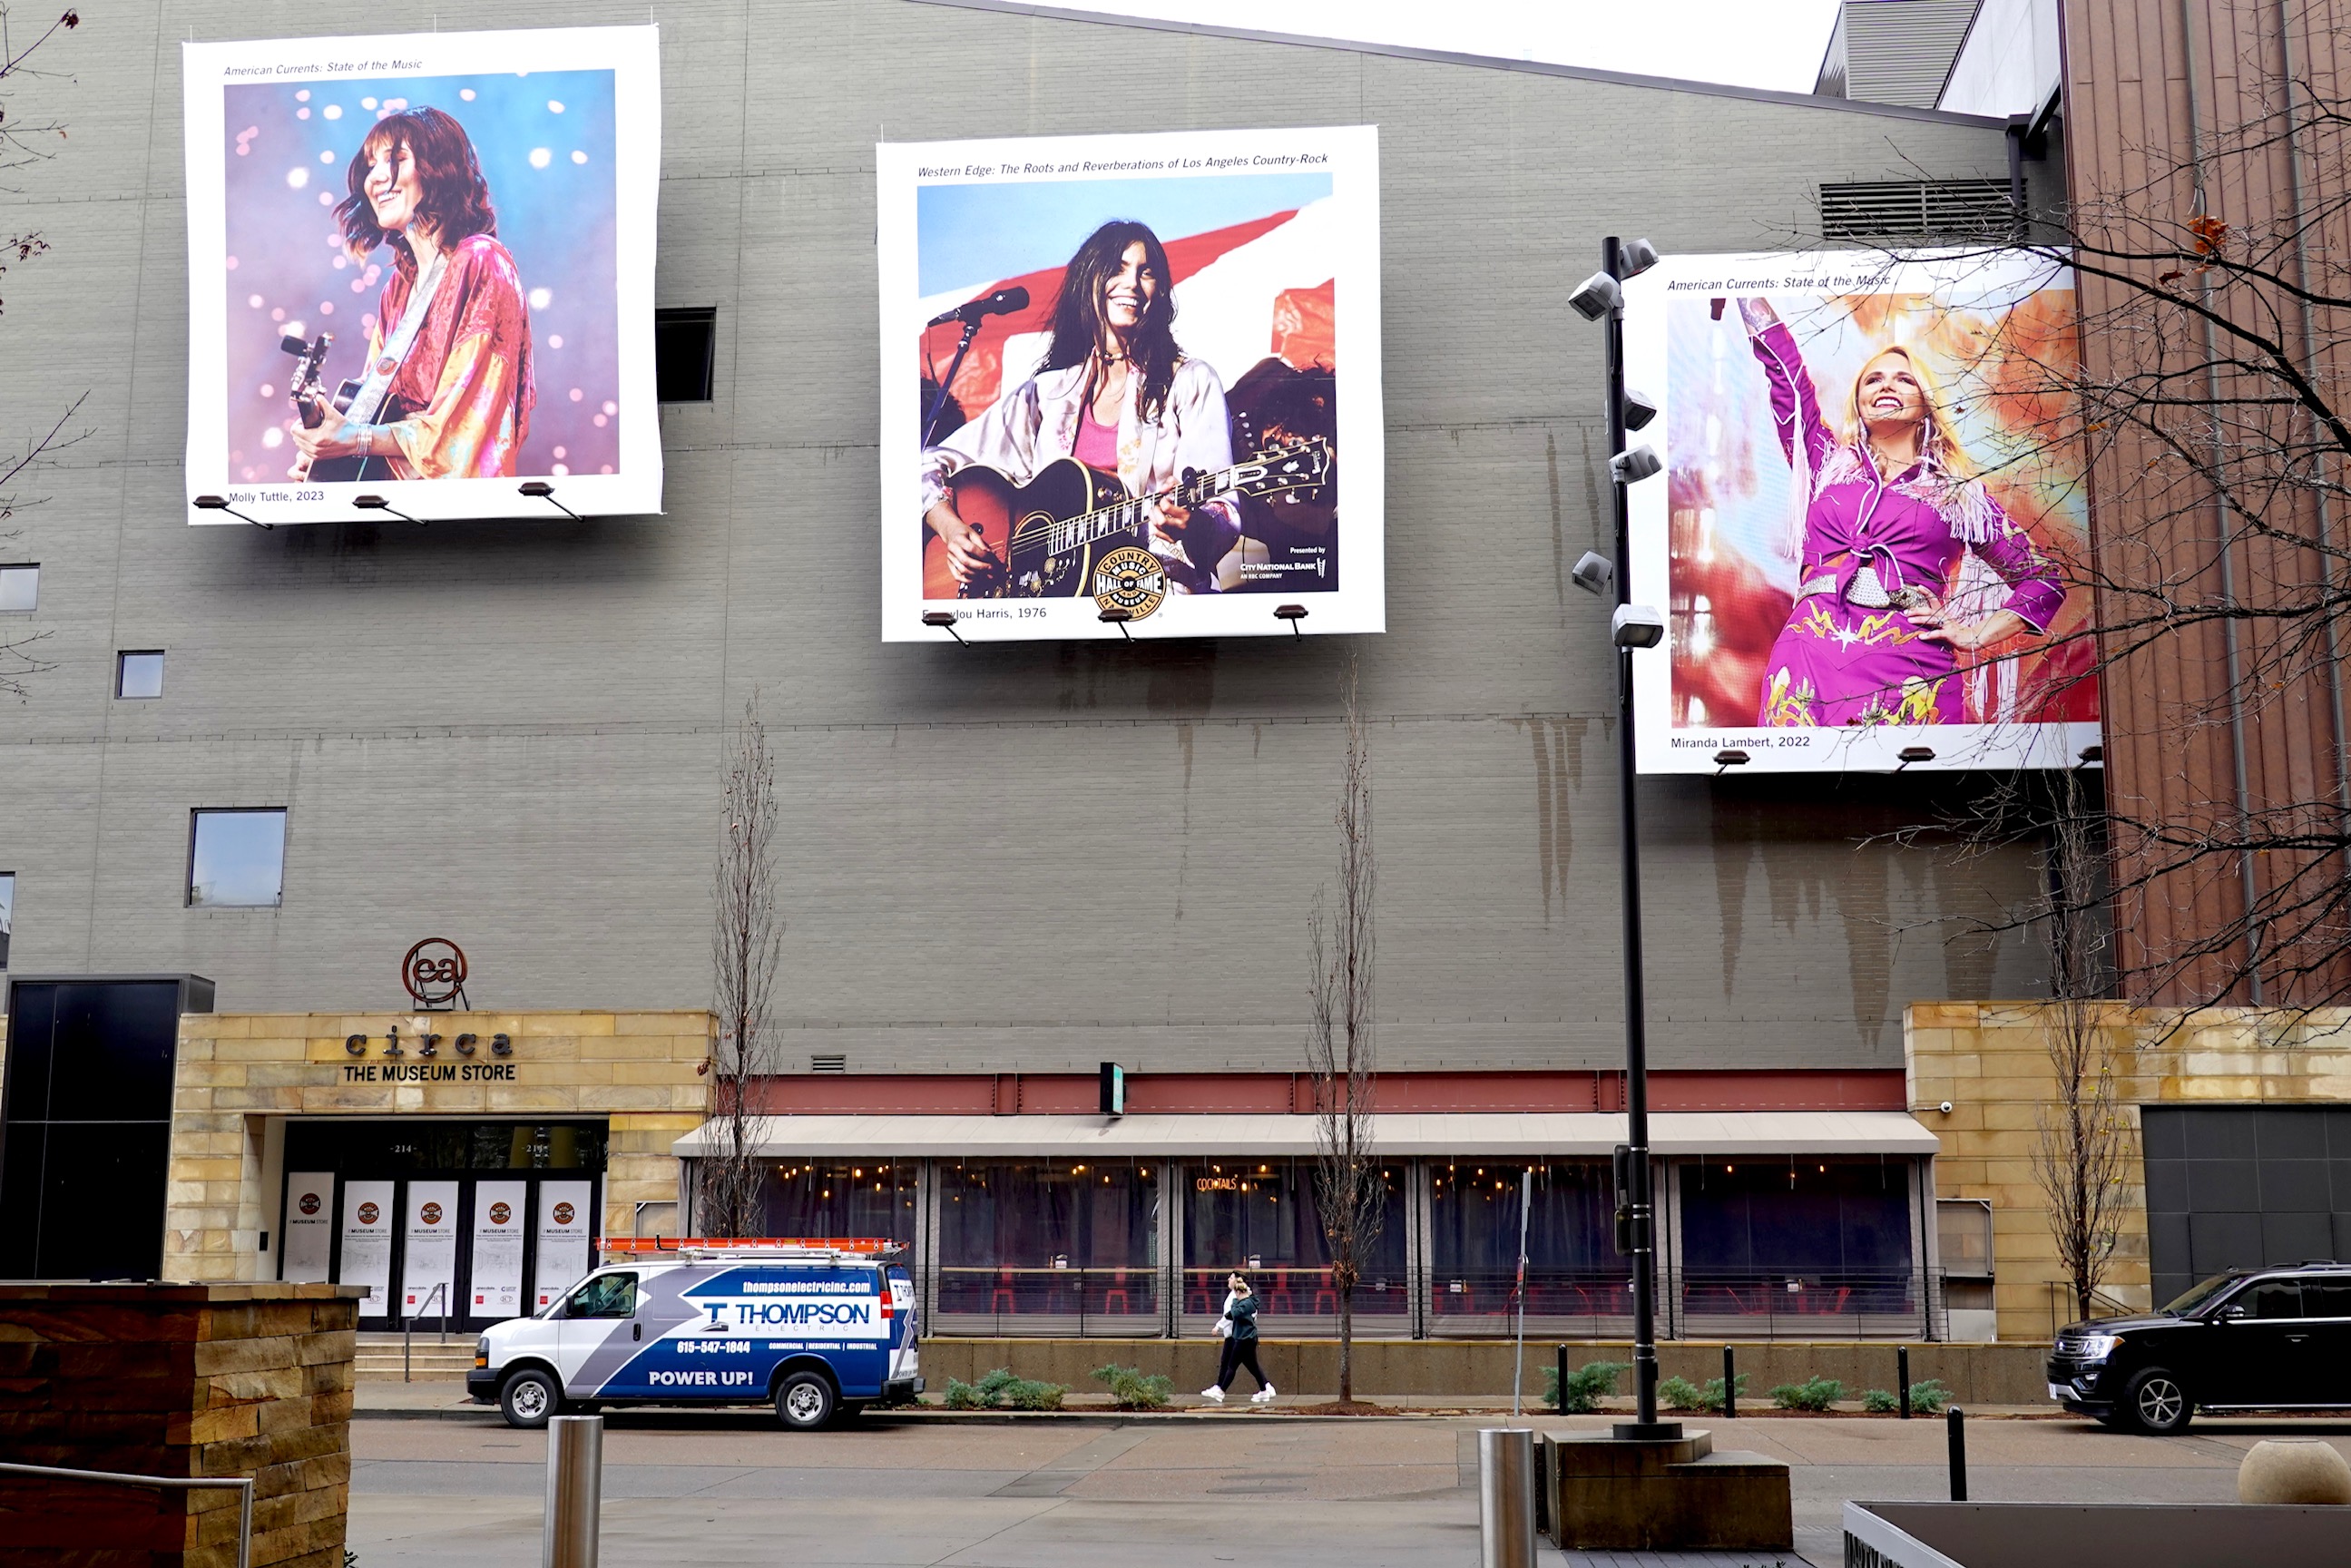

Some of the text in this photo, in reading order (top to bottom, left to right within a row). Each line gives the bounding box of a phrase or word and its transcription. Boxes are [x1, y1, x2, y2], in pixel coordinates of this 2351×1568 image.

[223, 59, 423, 76] American Currents: State of the Music
[918, 153, 1328, 178] Western Edge: The Roots and Reverberations of Los Angeles Country-Rock
[1668, 275, 1891, 291] American Currents: State of the Music
[229, 490, 324, 504] Molly Tuttle, 2023
[1289, 546, 1326, 554] Presented by
[1103, 552, 1156, 571] COUNTRY
[1112, 562, 1146, 576] MUSIC
[1096, 573, 1122, 596] HALL
[1136, 572, 1162, 594] FAME
[1102, 597, 1156, 614] NAVILLE
[1112, 593, 1146, 606] MUSEUM
[923, 607, 1047, 621] Eylou Harris, 1976
[1671, 736, 1810, 749] Miranda Lambert, 2022
[346, 1025, 513, 1055] circa
[344, 1064, 515, 1081] THE MUSEUM STORE
[1197, 1178, 1237, 1191] COCKTAILS
[742, 1281, 870, 1294] thompsonelectricinc.com
[735, 1303, 870, 1325] THOMPSON
[677, 1341, 750, 1354] 615-547-1844
[769, 1342, 877, 1350] COMMERCIAL RESIDENTIAL INDUSTRIAL
[649, 1371, 753, 1386] POWER UP!
